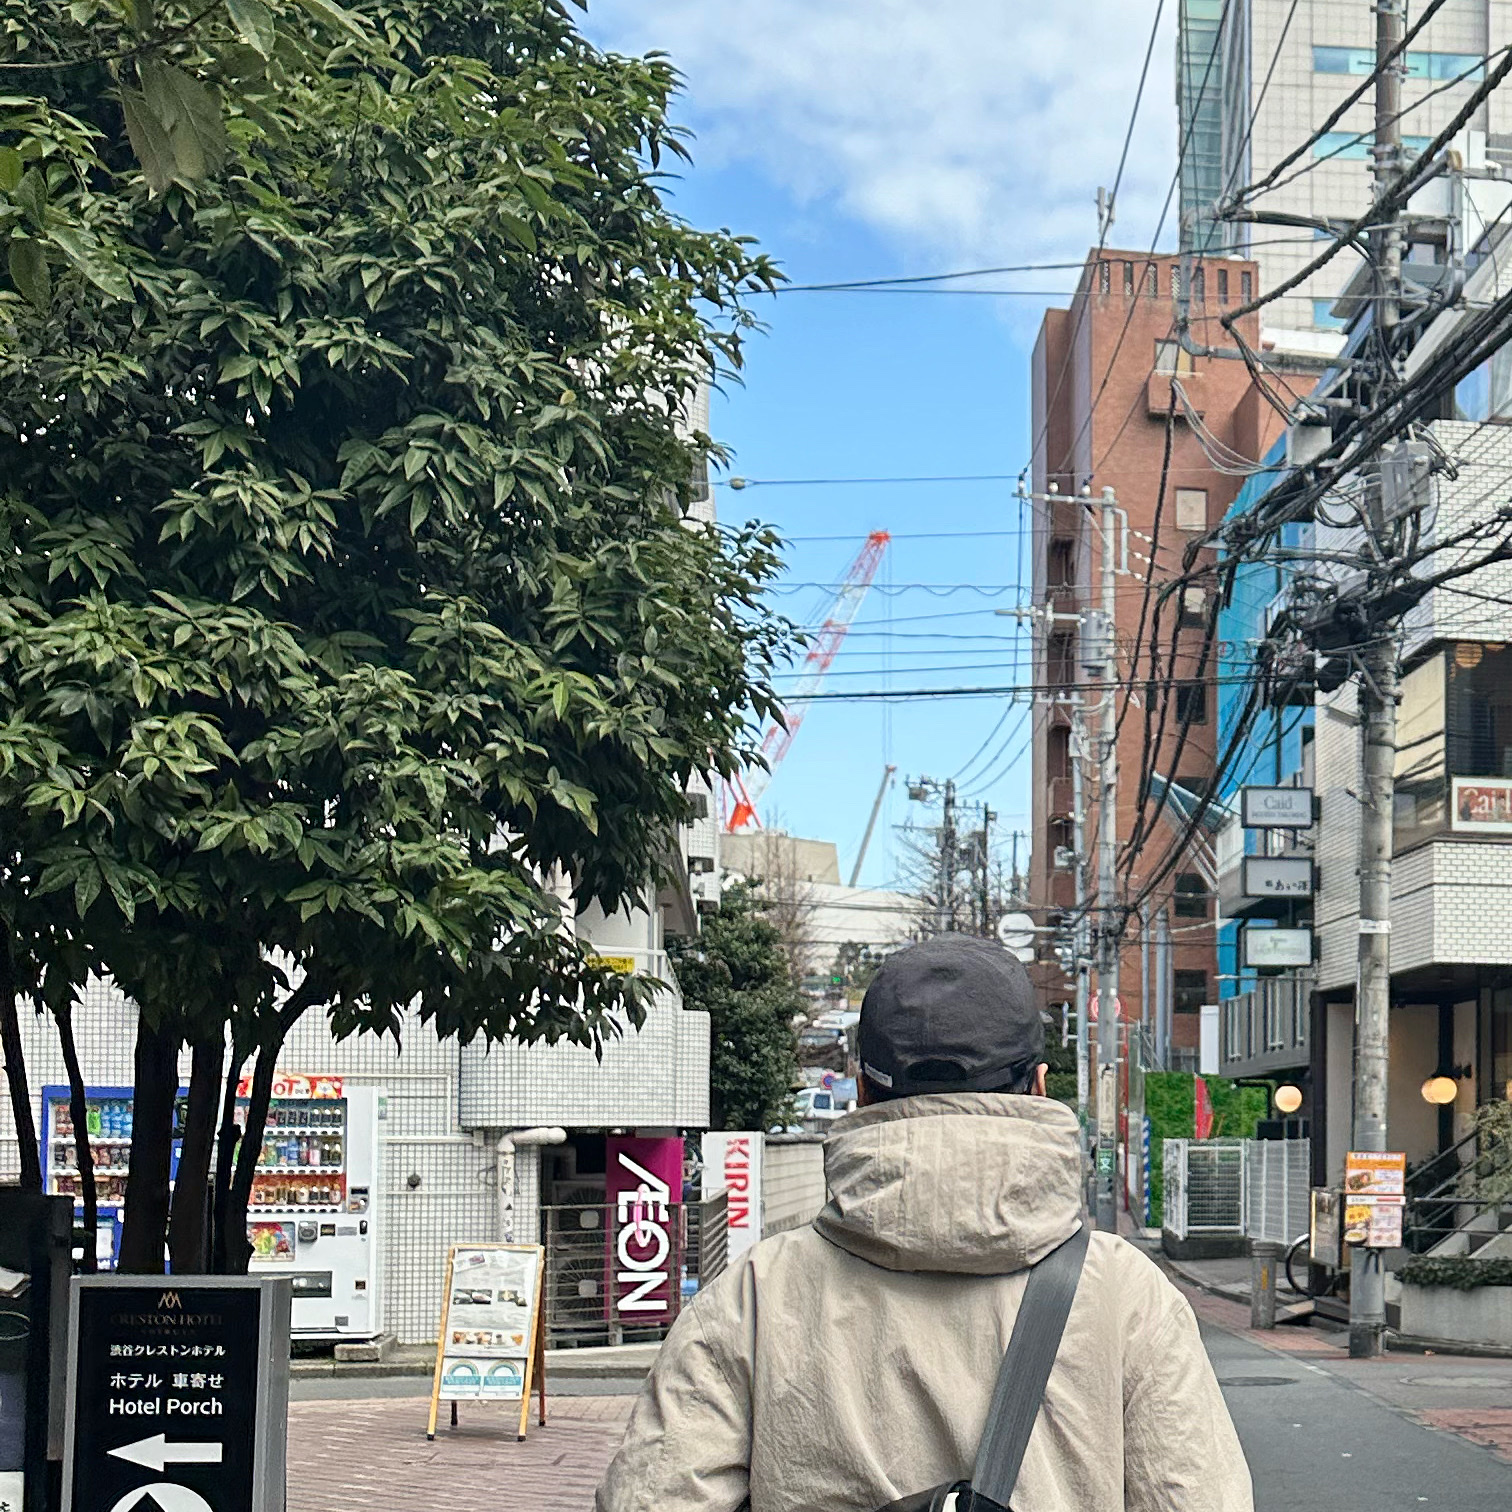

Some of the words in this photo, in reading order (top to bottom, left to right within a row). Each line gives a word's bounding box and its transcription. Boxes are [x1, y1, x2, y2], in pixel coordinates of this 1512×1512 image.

[724, 1138, 750, 1229] KIRIN
[110, 1344, 226, 1357] 渋谷クレストンホテル
[110, 1372, 163, 1389] ホテル
[172, 1372, 225, 1389] 車寄せ
[109, 1397, 160, 1415] Hotel
[166, 1397, 223, 1415] Porch
